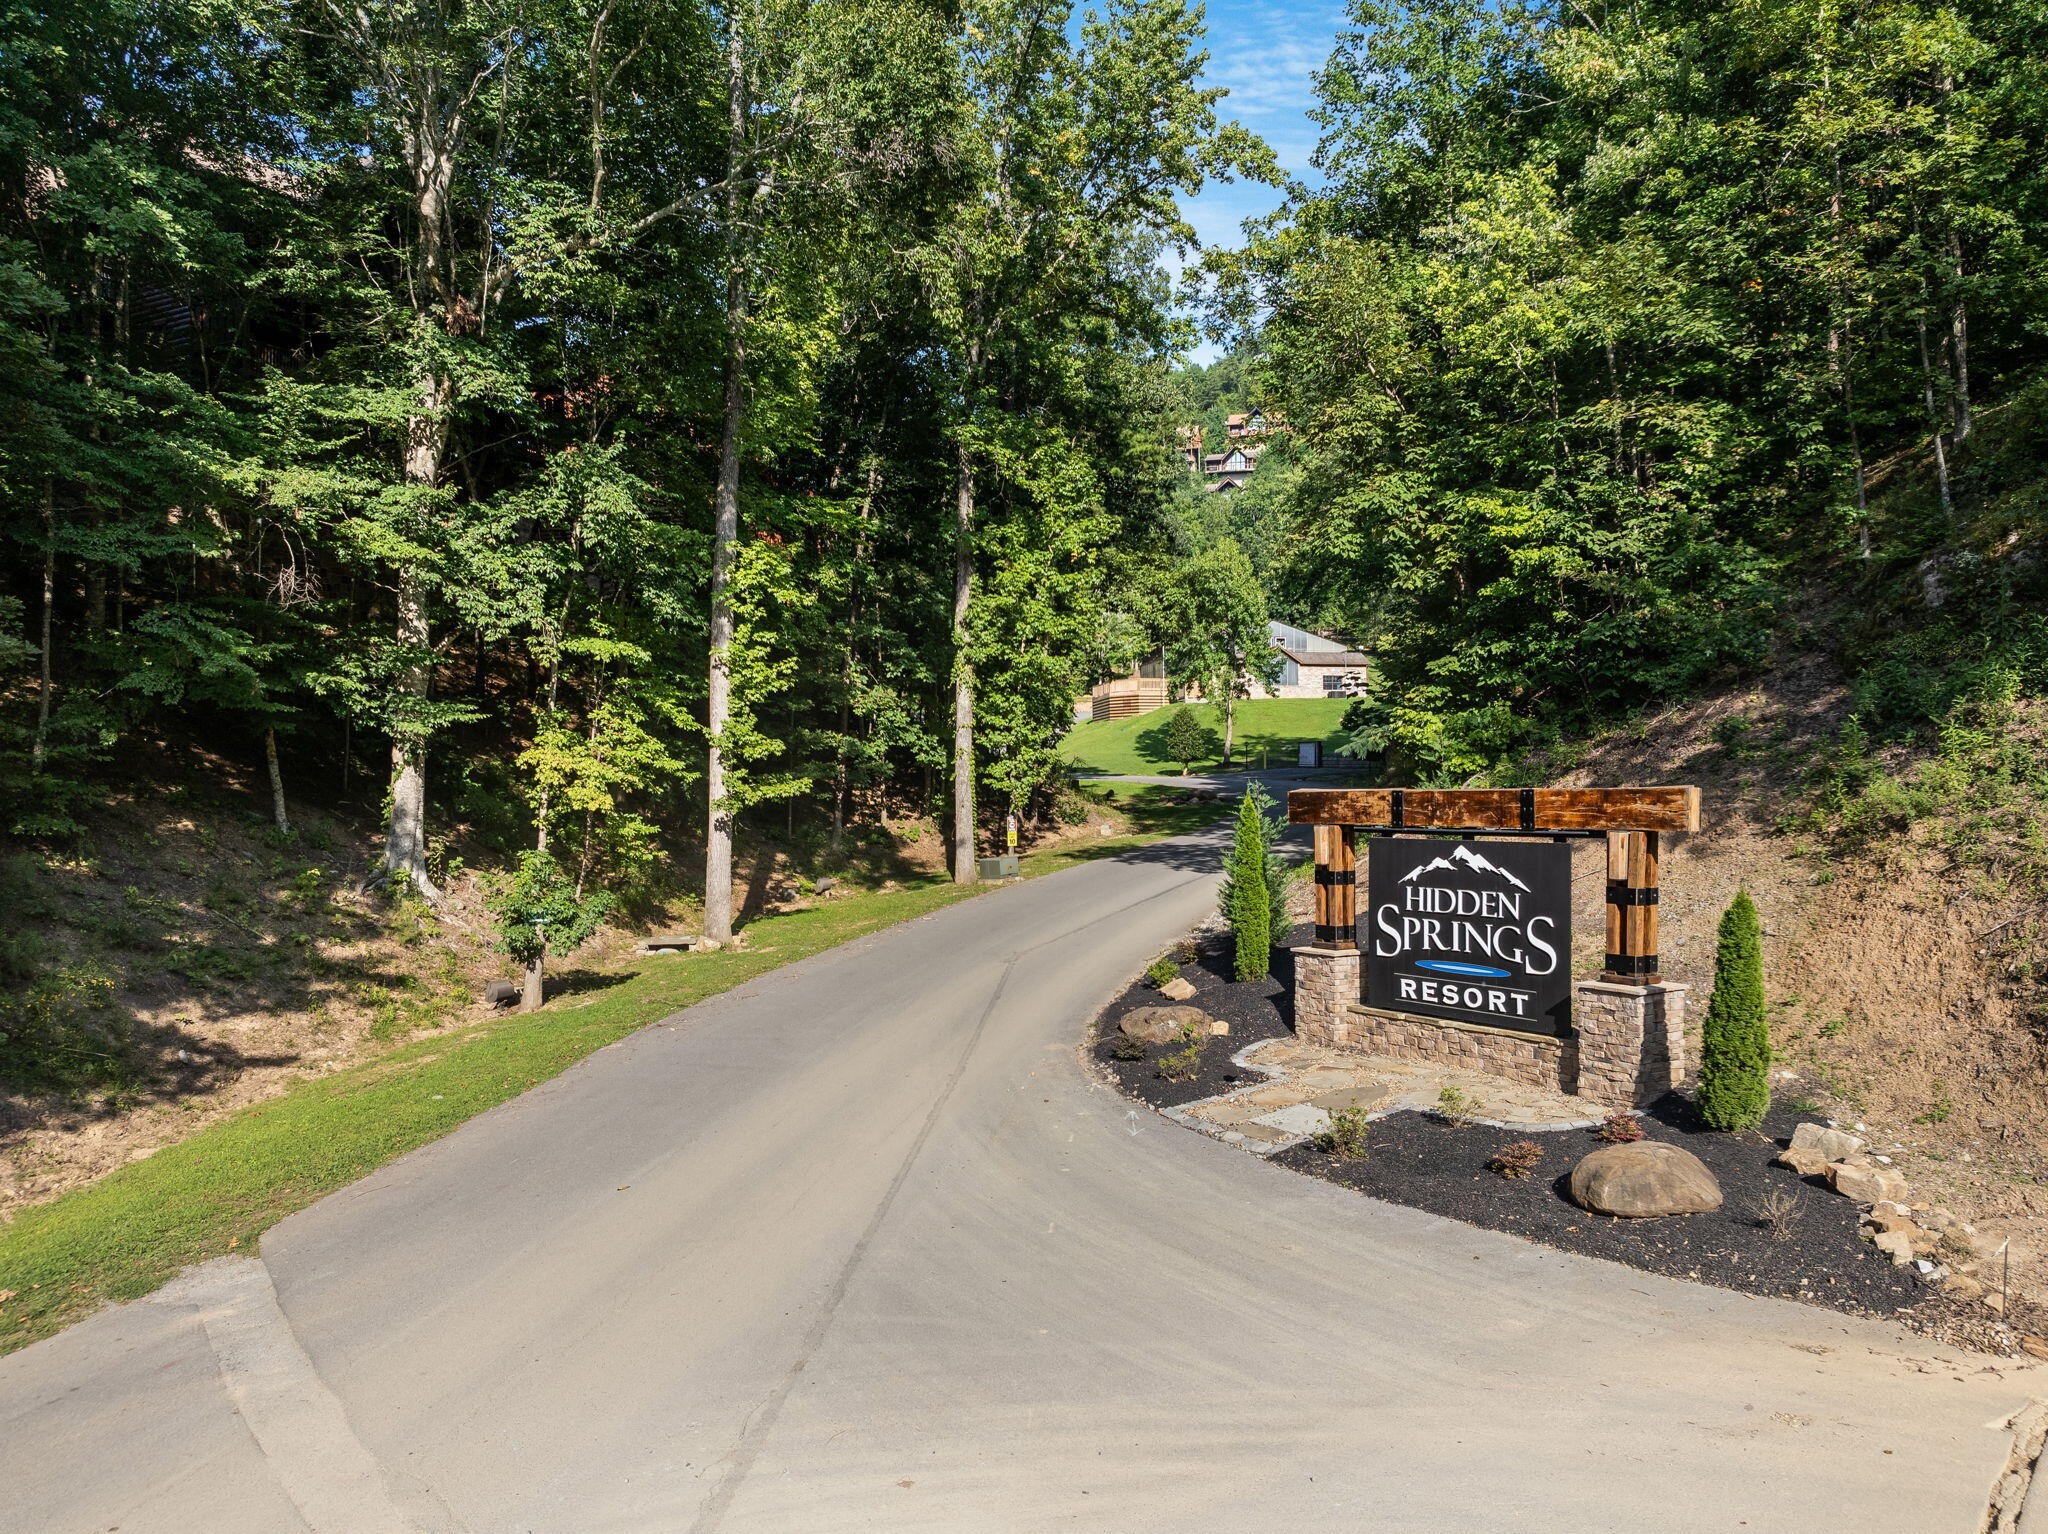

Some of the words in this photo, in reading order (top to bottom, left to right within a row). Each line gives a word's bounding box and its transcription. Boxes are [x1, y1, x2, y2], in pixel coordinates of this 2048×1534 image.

[1405, 886, 1521, 920] HIDDEN
[1376, 904, 1558, 975] SPRINGS
[1400, 979, 1529, 1016] RESORT
